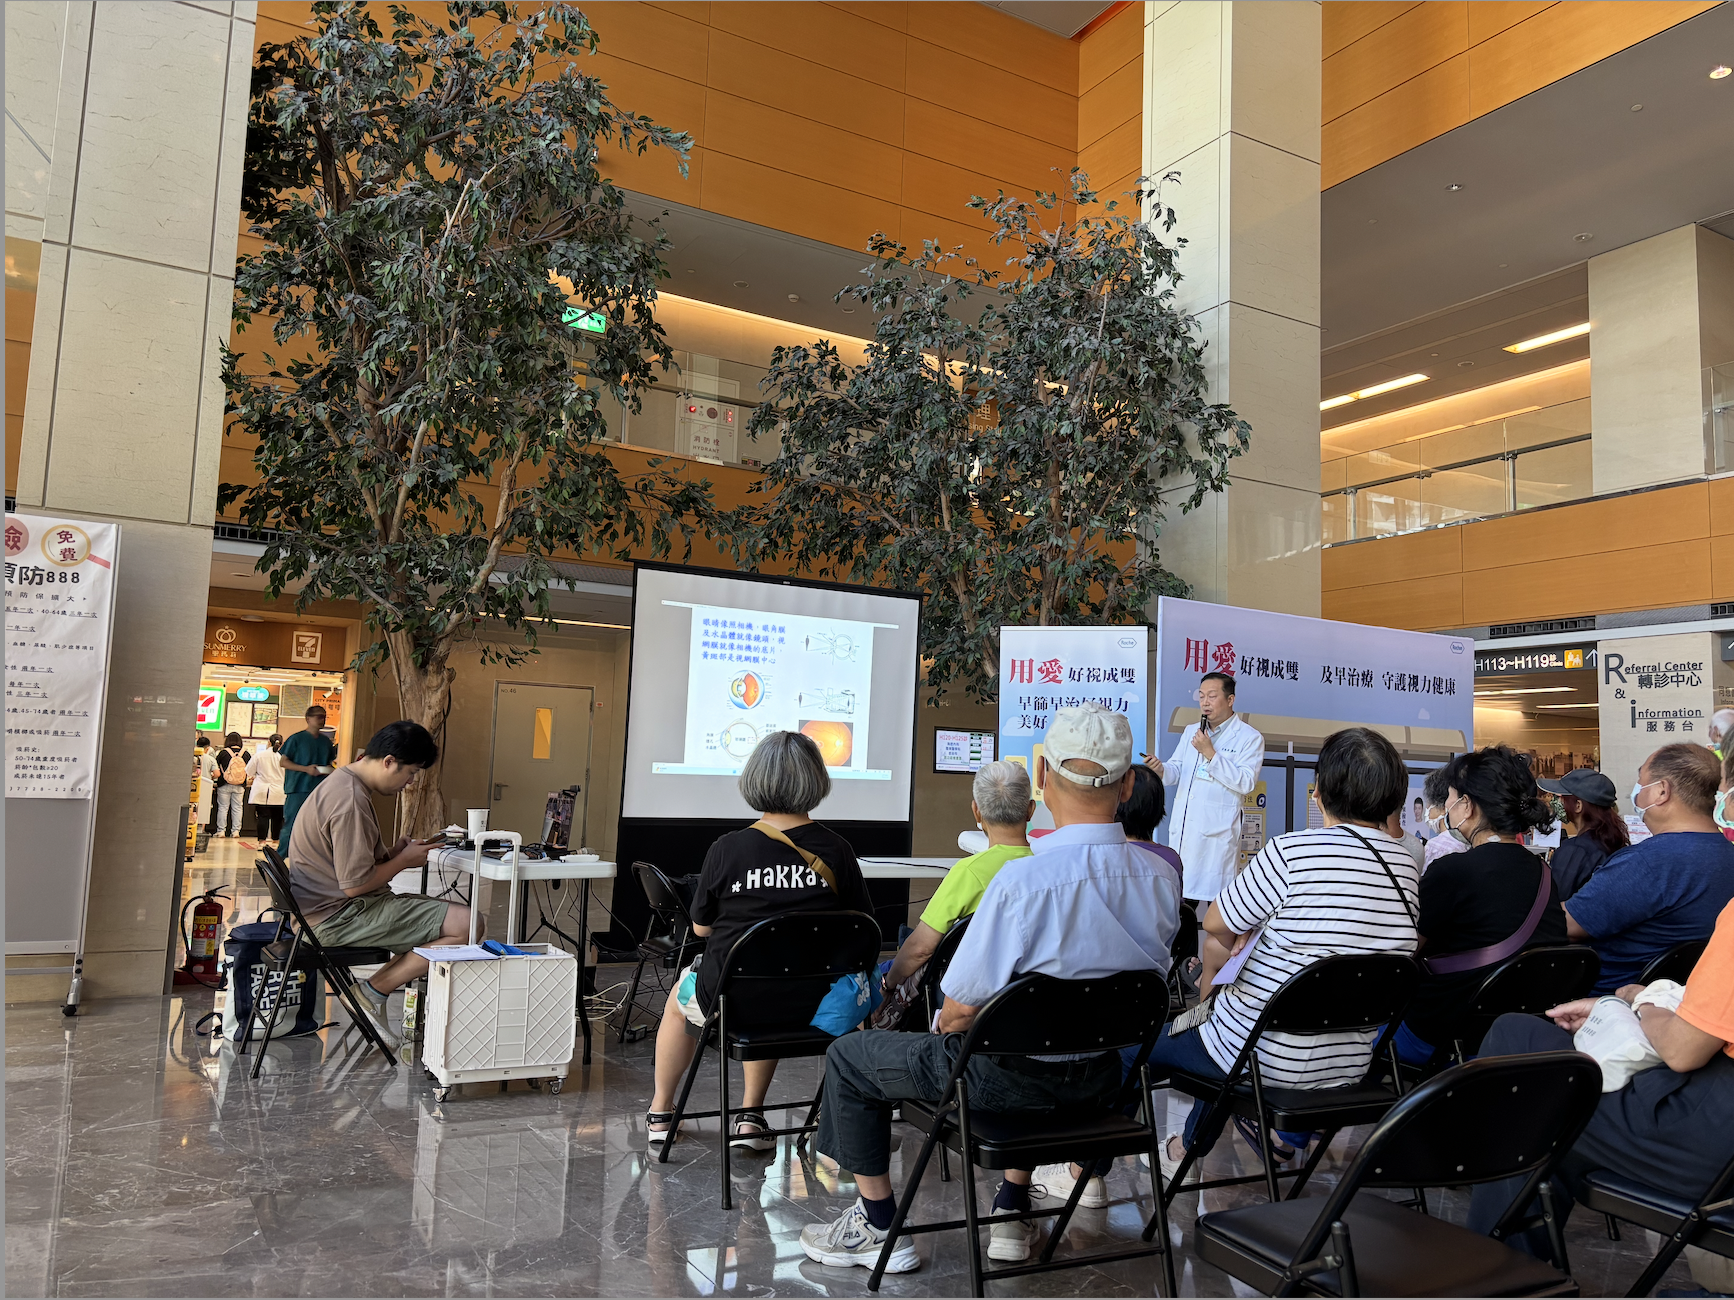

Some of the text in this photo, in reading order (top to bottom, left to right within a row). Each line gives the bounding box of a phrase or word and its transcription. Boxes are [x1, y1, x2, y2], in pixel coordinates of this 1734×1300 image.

[694, 435, 720, 446] 消防栓
[693, 445, 720, 454] HYDRANT
[56, 530, 78, 562] 免費
[204, 643, 247, 652] SUNMERRY
[1009, 658, 1136, 684] 用愛 好視成雙
[1184, 637, 1456, 696] 用愛 好視成雙 及早治療 守護視力健康
[1665, 661, 1703, 672] Center
[1637, 671, 1702, 689] 轉診中心
[1615, 688, 1626, 699] &
[1018, 696, 1128, 712] 早篩早治視力
[1018, 714, 1048, 730] 美好
[1646, 720, 1693, 732] 服務台
